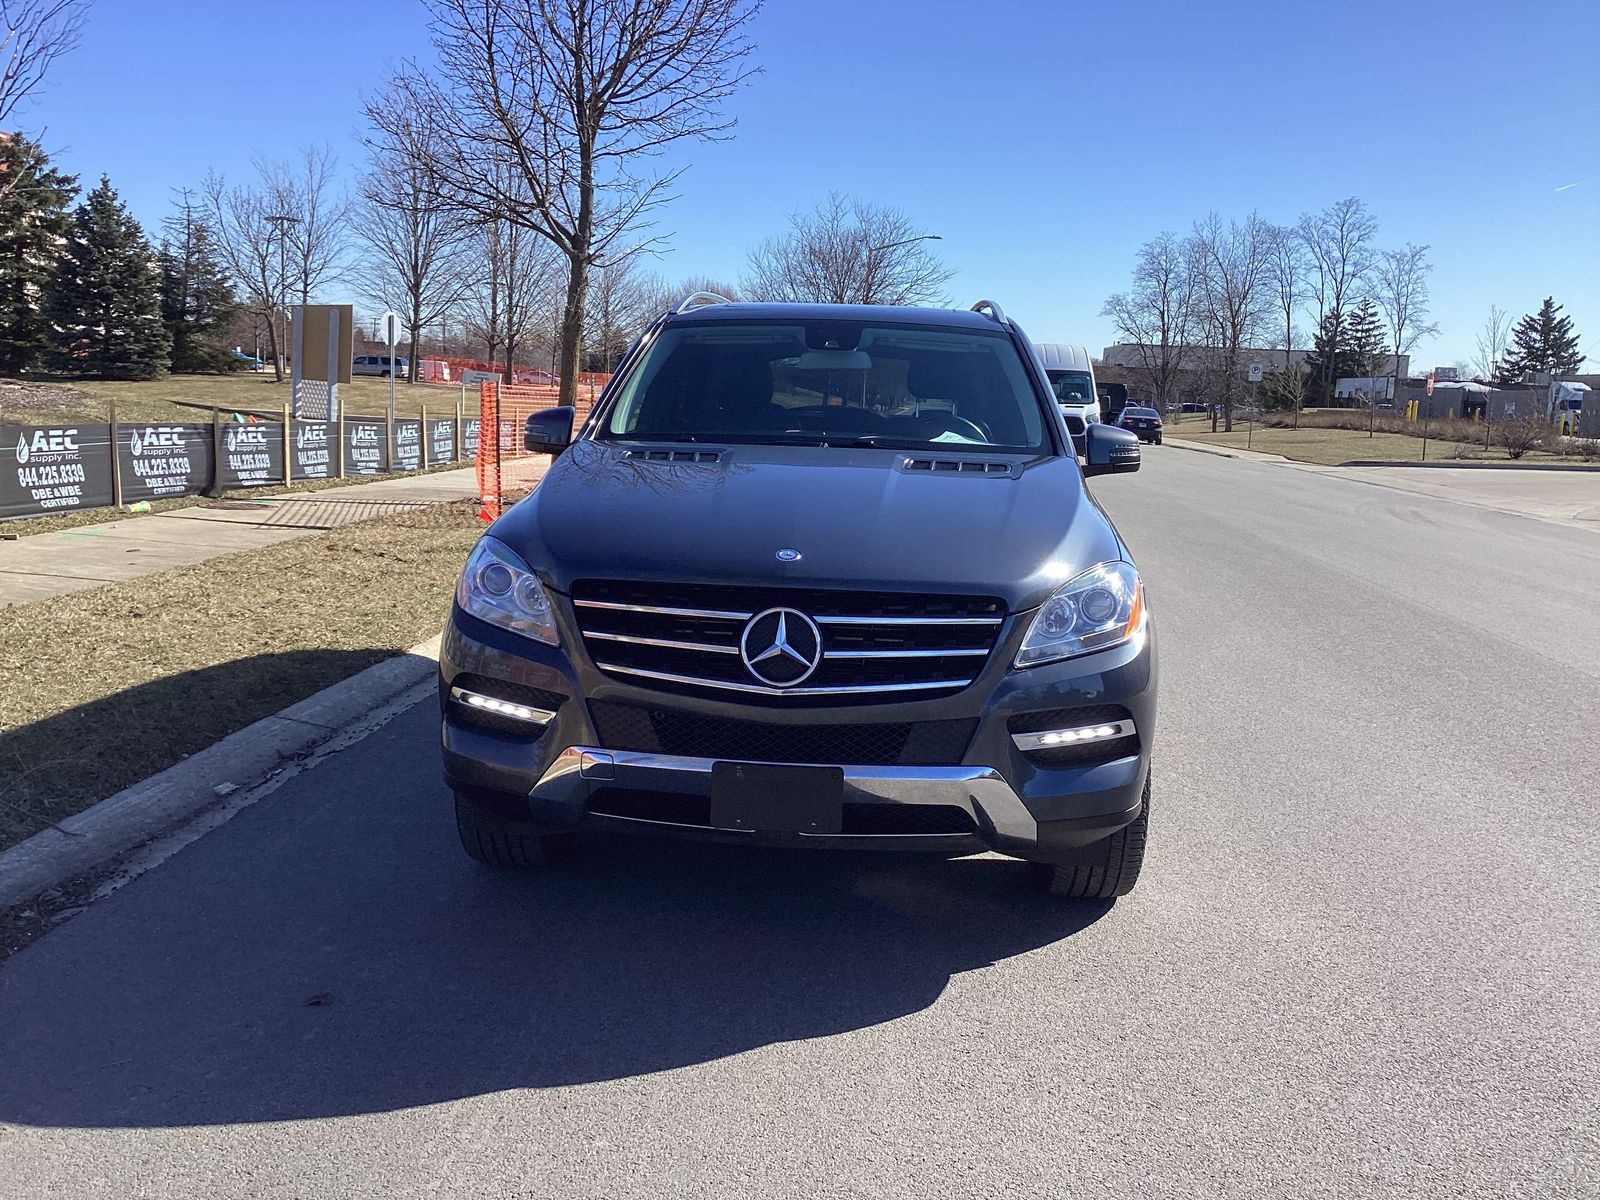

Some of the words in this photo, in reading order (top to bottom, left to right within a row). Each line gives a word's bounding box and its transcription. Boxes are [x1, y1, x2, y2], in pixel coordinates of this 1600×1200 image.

[143, 427, 186, 446] AEC
[236, 426, 267, 442] AEC
[304, 425, 327, 440] AEC
[357, 425, 378, 439] AEC
[402, 424, 418, 438] AEC
[30, 429, 79, 452] AEC
[30, 454, 63, 464] supply
[143, 448, 171, 456] supply
[132, 457, 191, 477] 844.225.8339
[17, 463, 85, 487] 844.225.8339
[153, 485, 185, 495] CERTIFIED
[40, 497, 80, 508] CERTIFIED
